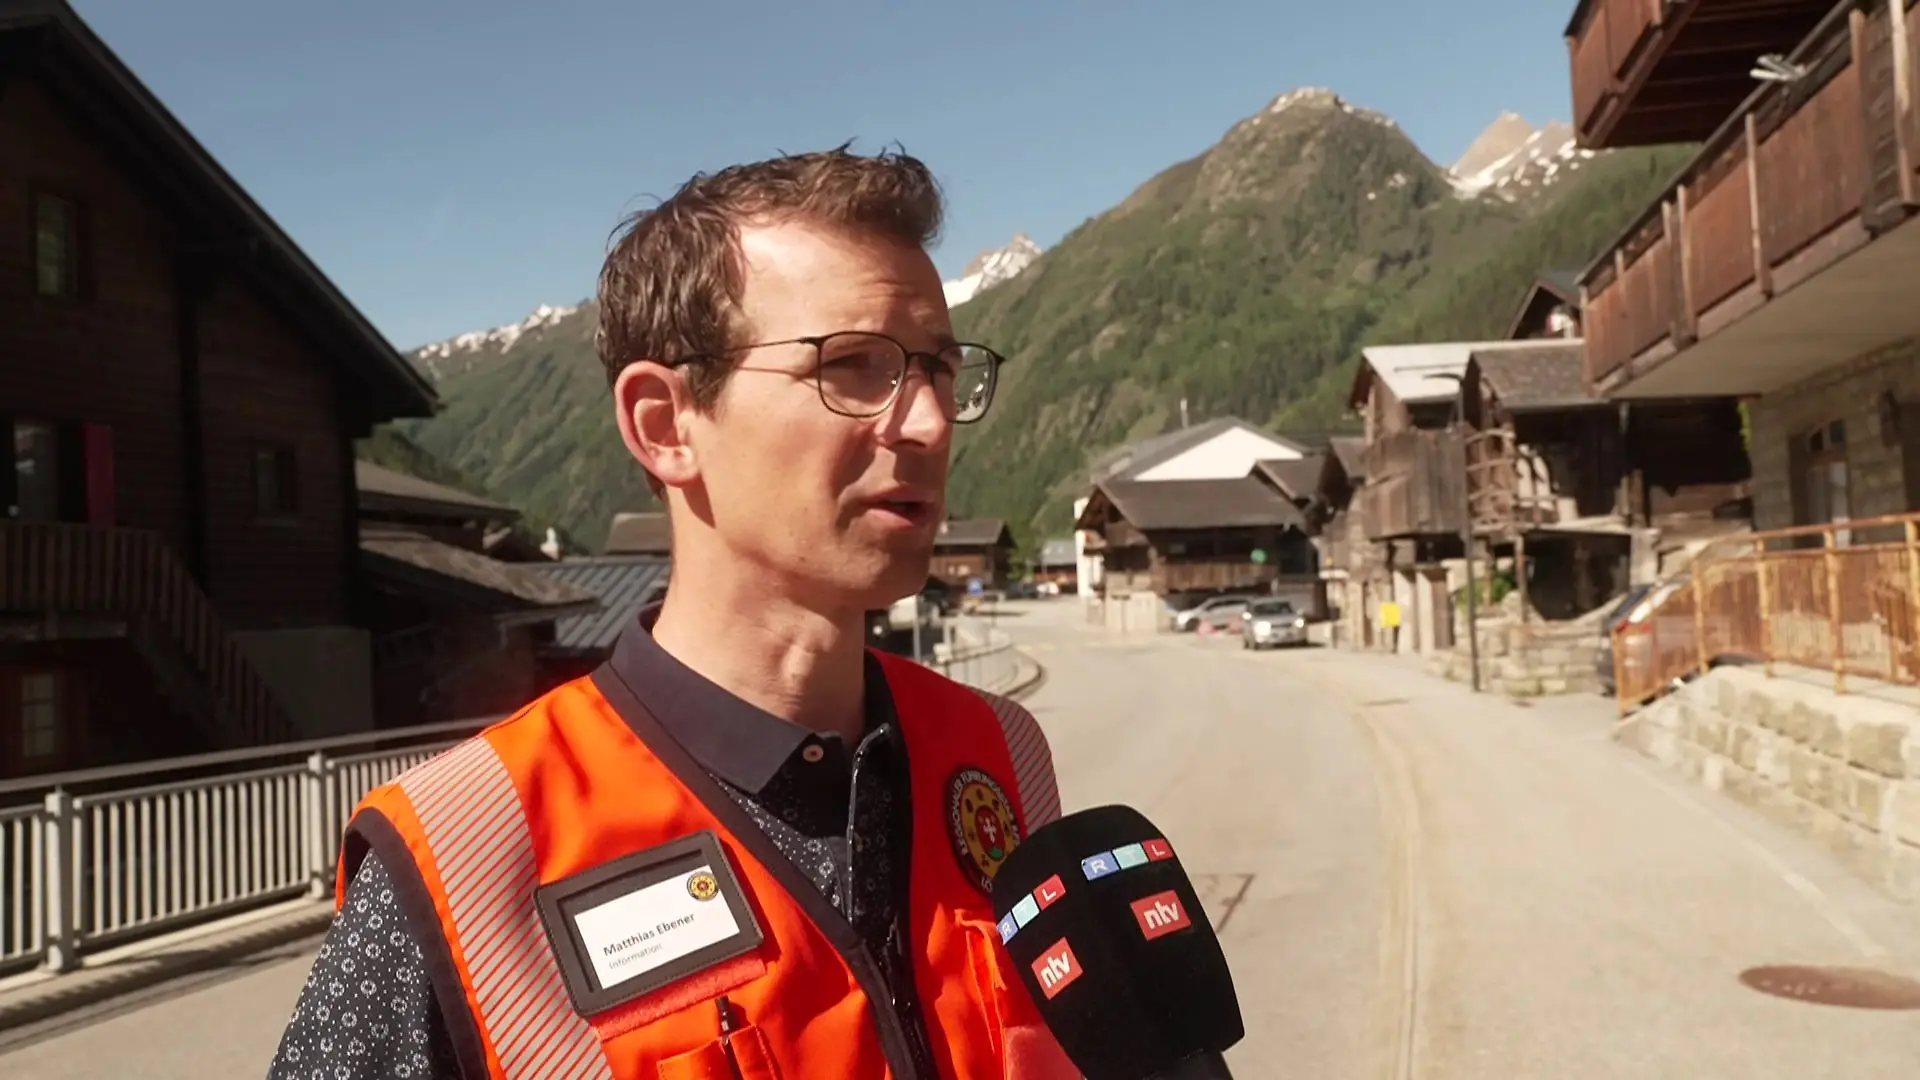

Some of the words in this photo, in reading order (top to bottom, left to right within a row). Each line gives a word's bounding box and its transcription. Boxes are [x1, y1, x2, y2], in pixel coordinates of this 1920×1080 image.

[1088, 842, 1167, 875] RTL
[1000, 885, 1059, 939] RTL
[1143, 900, 1180, 930] ntv
[603, 930, 655, 956] Matthias
[656, 913, 695, 935] Ebener
[609, 943, 662, 969] Information
[1040, 951, 1071, 989] ntv
